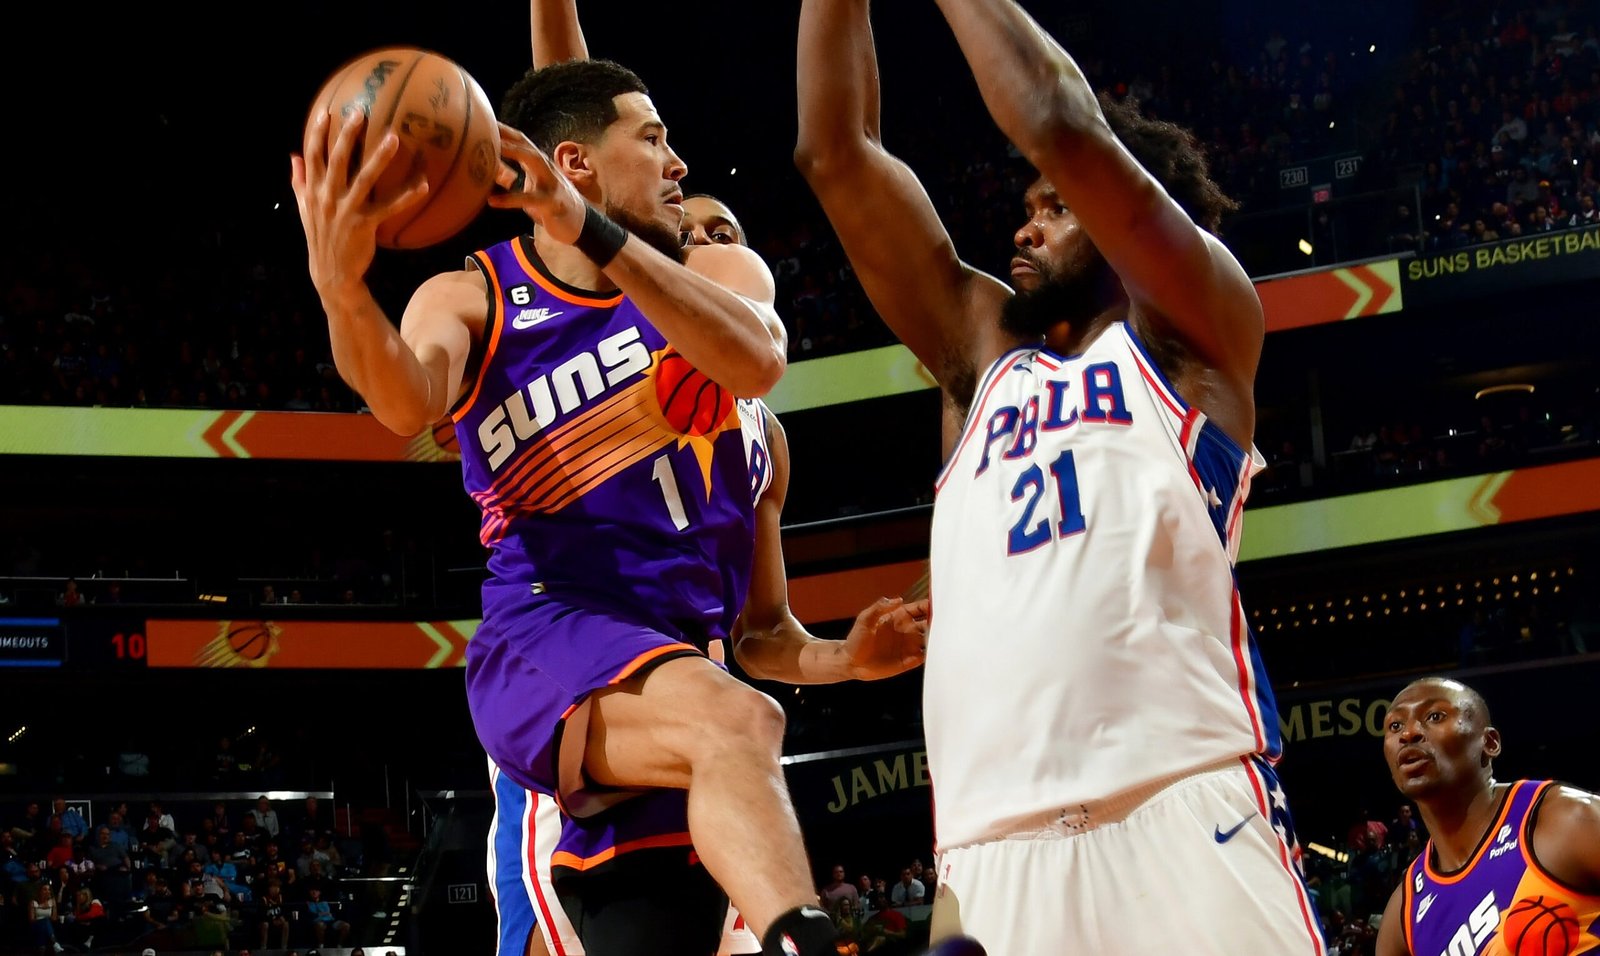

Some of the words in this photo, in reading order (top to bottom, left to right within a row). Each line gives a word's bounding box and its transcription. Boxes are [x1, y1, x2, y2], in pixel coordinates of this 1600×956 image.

[1283, 170, 1304, 185] 230
[1338, 159, 1358, 175] 231
[1408, 252, 1470, 281] SUNS
[510, 285, 531, 305] 6
[519, 307, 551, 321] NIKE
[651, 453, 690, 532] 1
[1007, 448, 1087, 558] 21
[111, 633, 146, 659] 10
[1489, 838, 1518, 860] PayPal
[1415, 872, 1424, 893] 6
[454, 887, 472, 901] 121
[1440, 889, 1500, 956] NS
